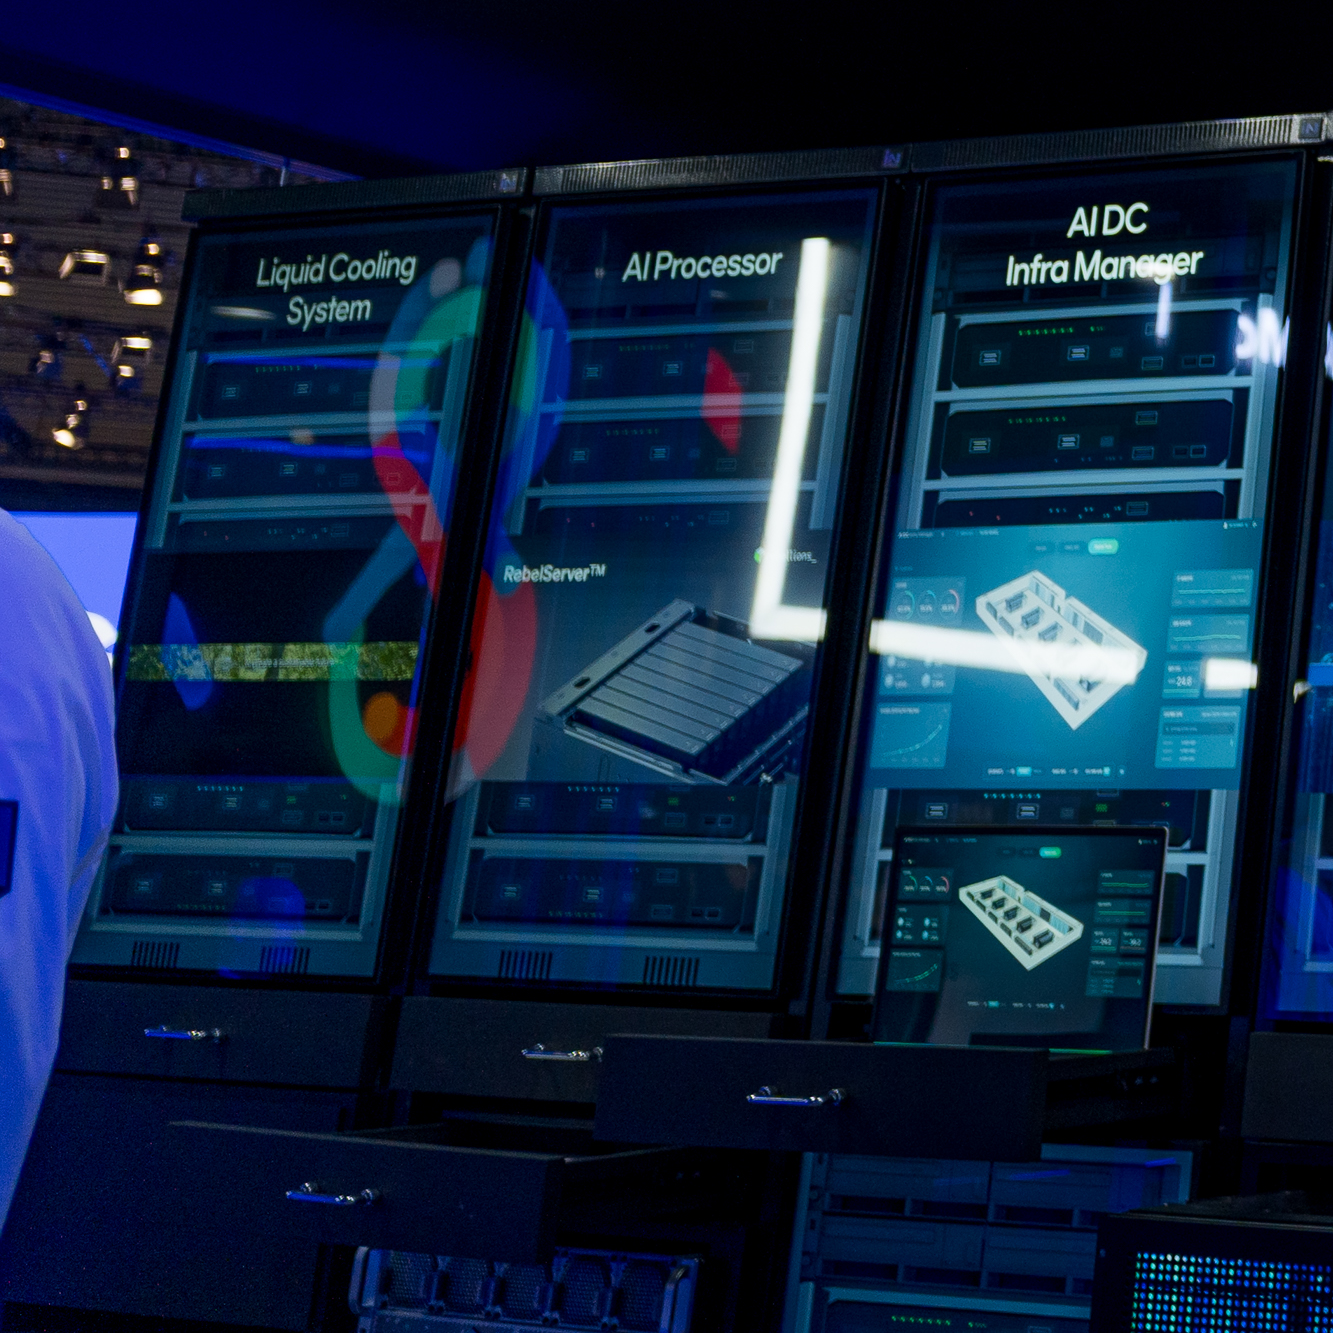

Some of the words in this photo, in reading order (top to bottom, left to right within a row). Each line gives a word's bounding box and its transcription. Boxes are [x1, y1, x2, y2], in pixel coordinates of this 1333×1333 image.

[1066, 205, 1098, 238] AI
[1102, 202, 1149, 236] DC
[256, 254, 326, 293] Liquid
[328, 249, 418, 286] Cooling
[622, 252, 651, 283] AI
[653, 250, 783, 281] Processor
[1006, 253, 1070, 286] Infra
[1073, 249, 1204, 286] Manager
[286, 295, 372, 332] System
